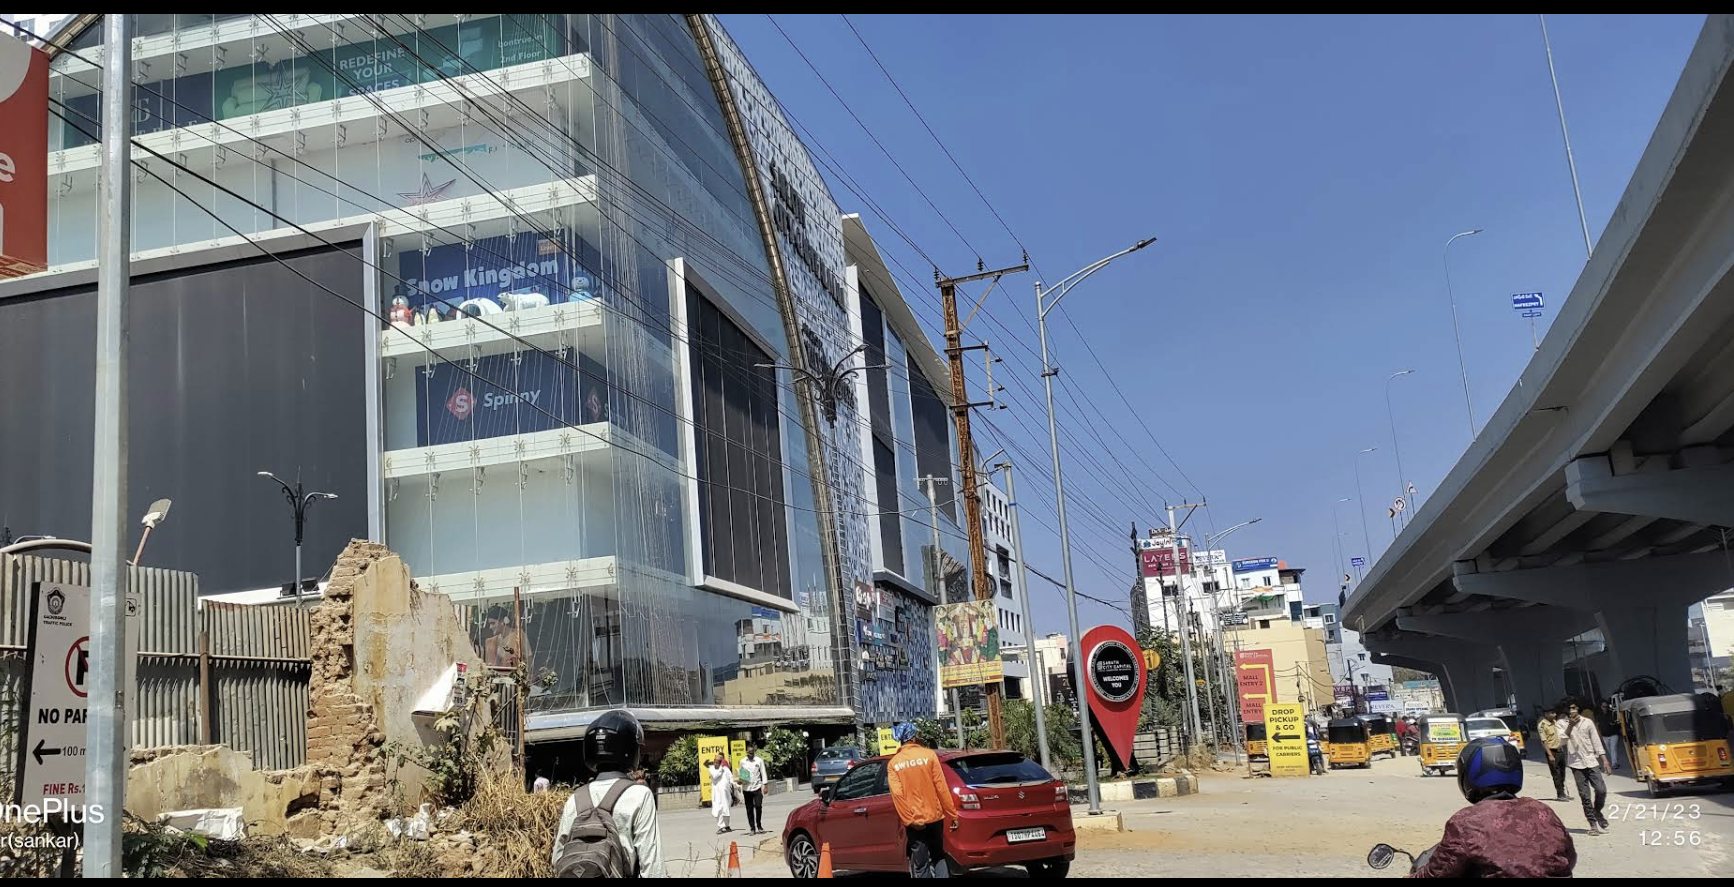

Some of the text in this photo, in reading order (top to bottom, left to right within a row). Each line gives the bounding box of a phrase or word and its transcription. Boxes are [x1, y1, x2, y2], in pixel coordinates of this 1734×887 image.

[339, 47, 407, 71] REDEFINE
[518, 49, 541, 61] Floor
[353, 62, 393, 80] YOUR
[406, 259, 558, 296] Snow Kingdom
[482, 388, 542, 411] Spinny
[1144, 552, 1186, 563] LAYES
[38, 709, 60, 724] NO
[62, 746, 79, 757] 100
[701, 745, 725, 755] ENTRY
[894, 757, 929, 772] SWIGGY
[43, 784, 65, 796] FINE
